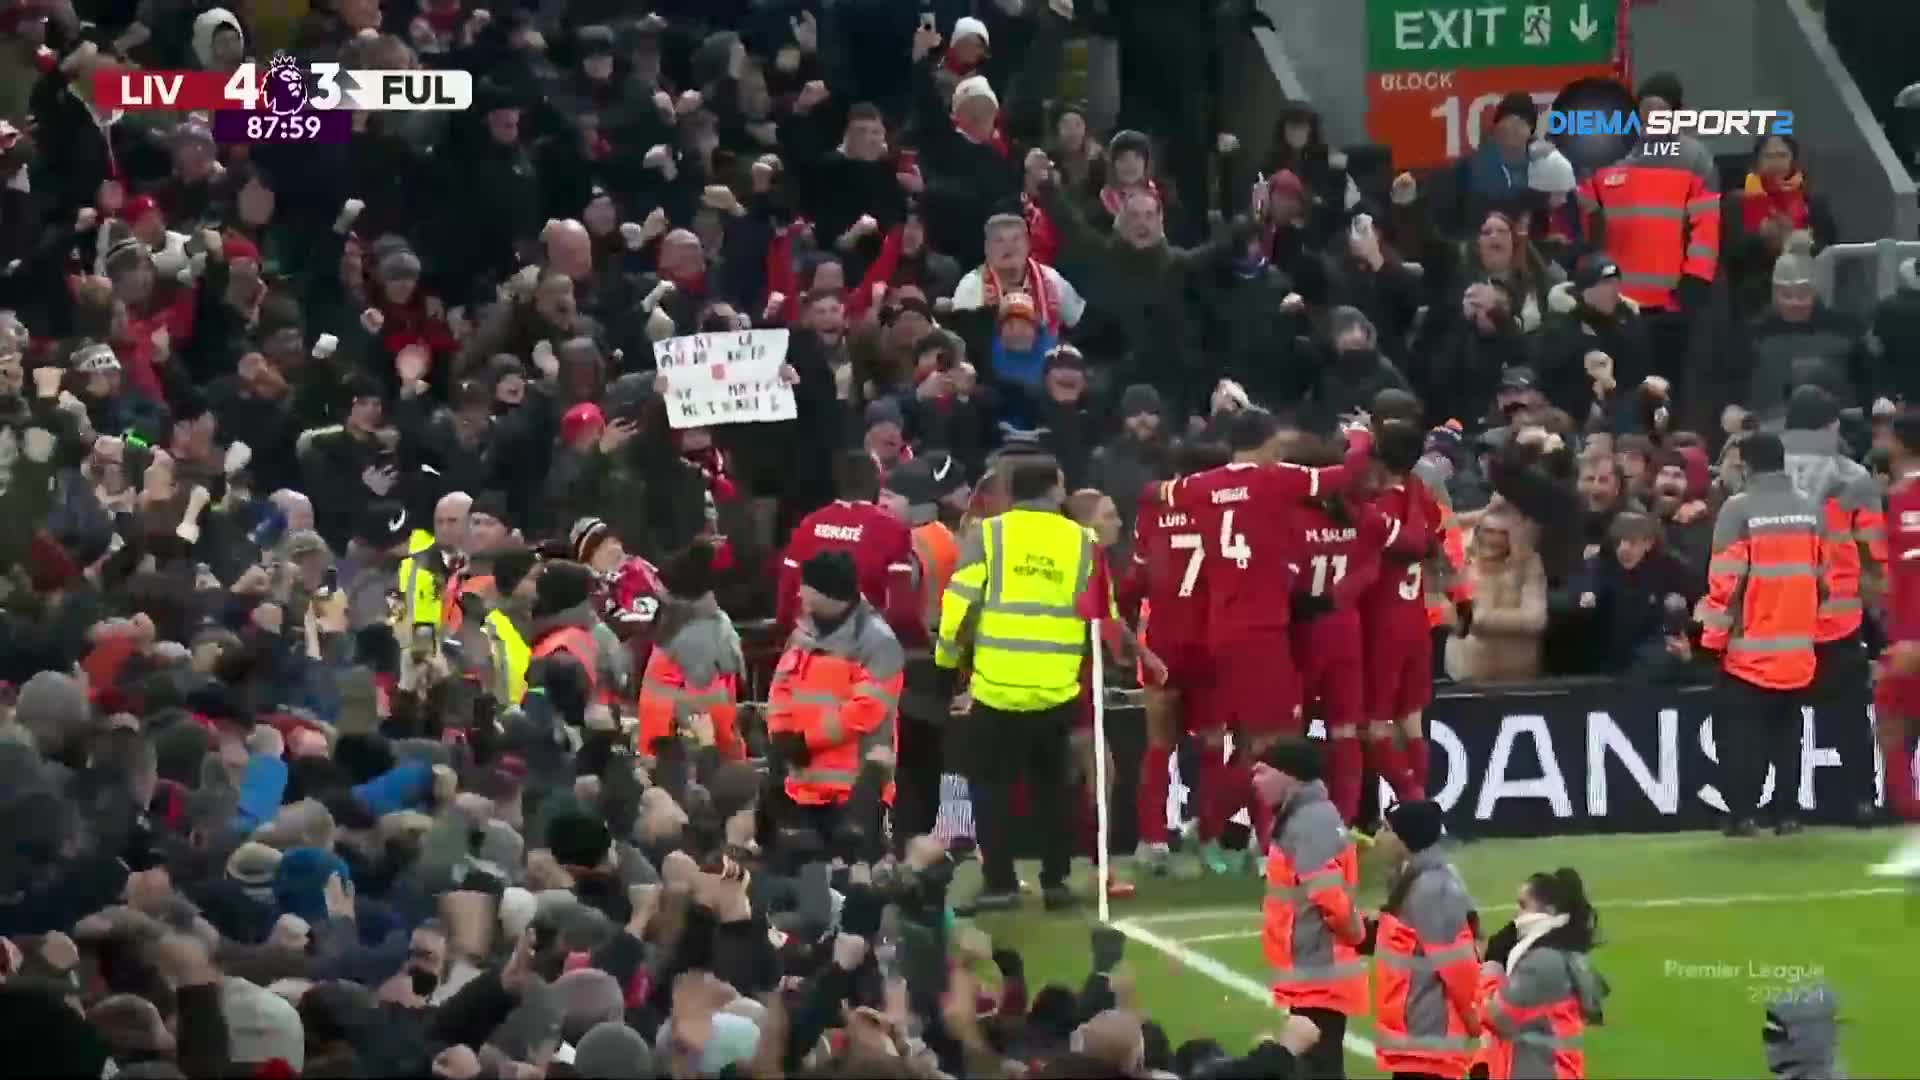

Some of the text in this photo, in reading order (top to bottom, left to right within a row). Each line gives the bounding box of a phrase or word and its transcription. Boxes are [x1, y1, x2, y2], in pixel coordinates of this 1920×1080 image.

[1394, 8, 1505, 50] EXIT
[1380, 71, 1454, 91] BLOCK
[1170, 533, 1206, 597] 7
[1220, 510, 1251, 570] 4
